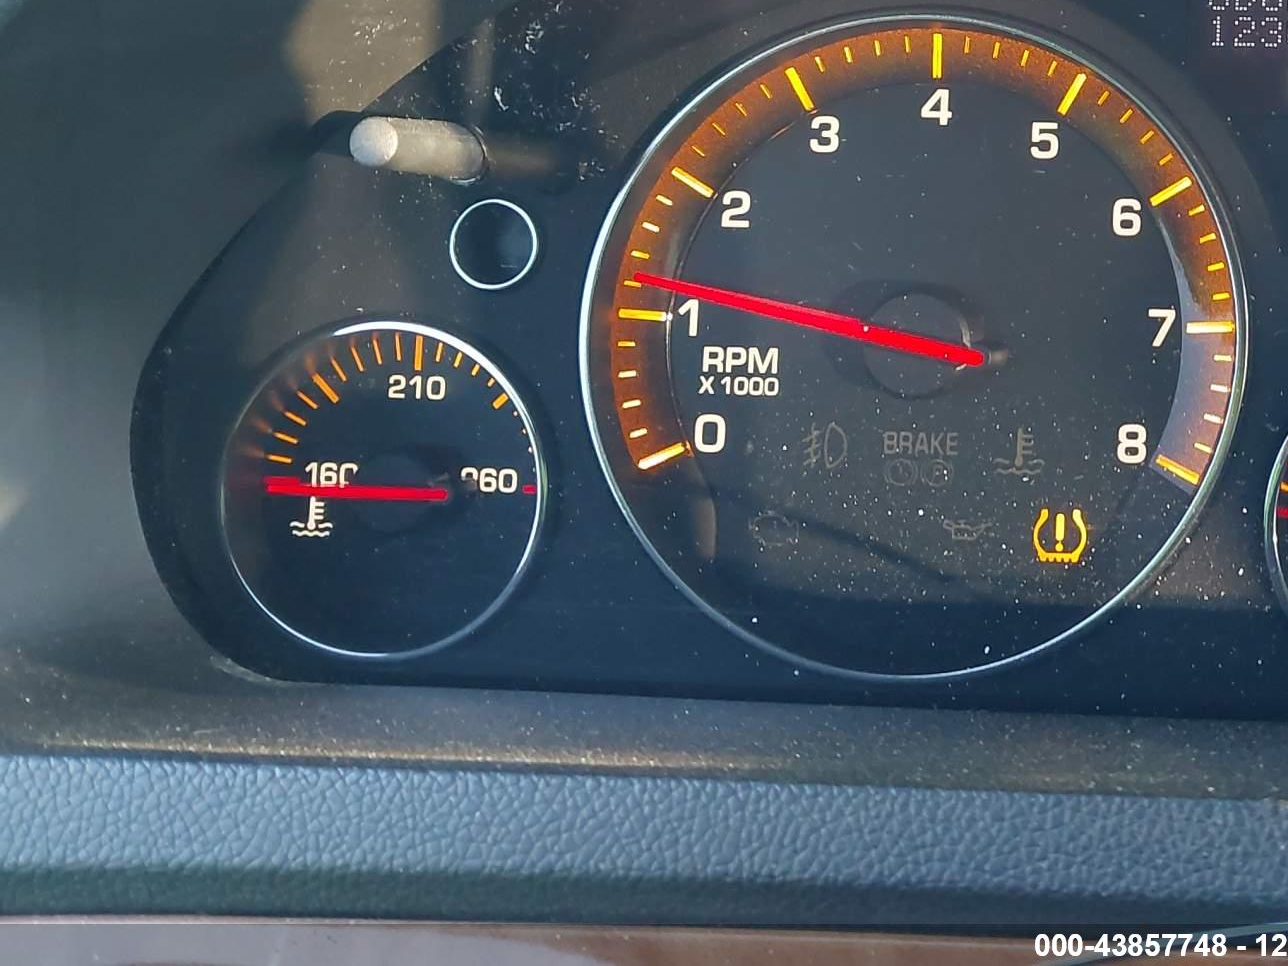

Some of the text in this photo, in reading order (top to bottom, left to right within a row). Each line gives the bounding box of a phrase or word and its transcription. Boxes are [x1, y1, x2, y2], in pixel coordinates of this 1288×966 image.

[921, 89, 952, 125] 4
[810, 116, 839, 152] 3
[1031, 122, 1058, 158] 5
[721, 191, 750, 227] 2
[1113, 199, 1141, 236] 6
[678, 299, 699, 336] 1
[1149, 309, 1175, 346] 7
[703, 347, 778, 374] RPM
[389, 375, 445, 399] 210
[695, 414, 725, 452] 0
[883, 432, 959, 455] BRAKE
[1117, 424, 1146, 463] 8
